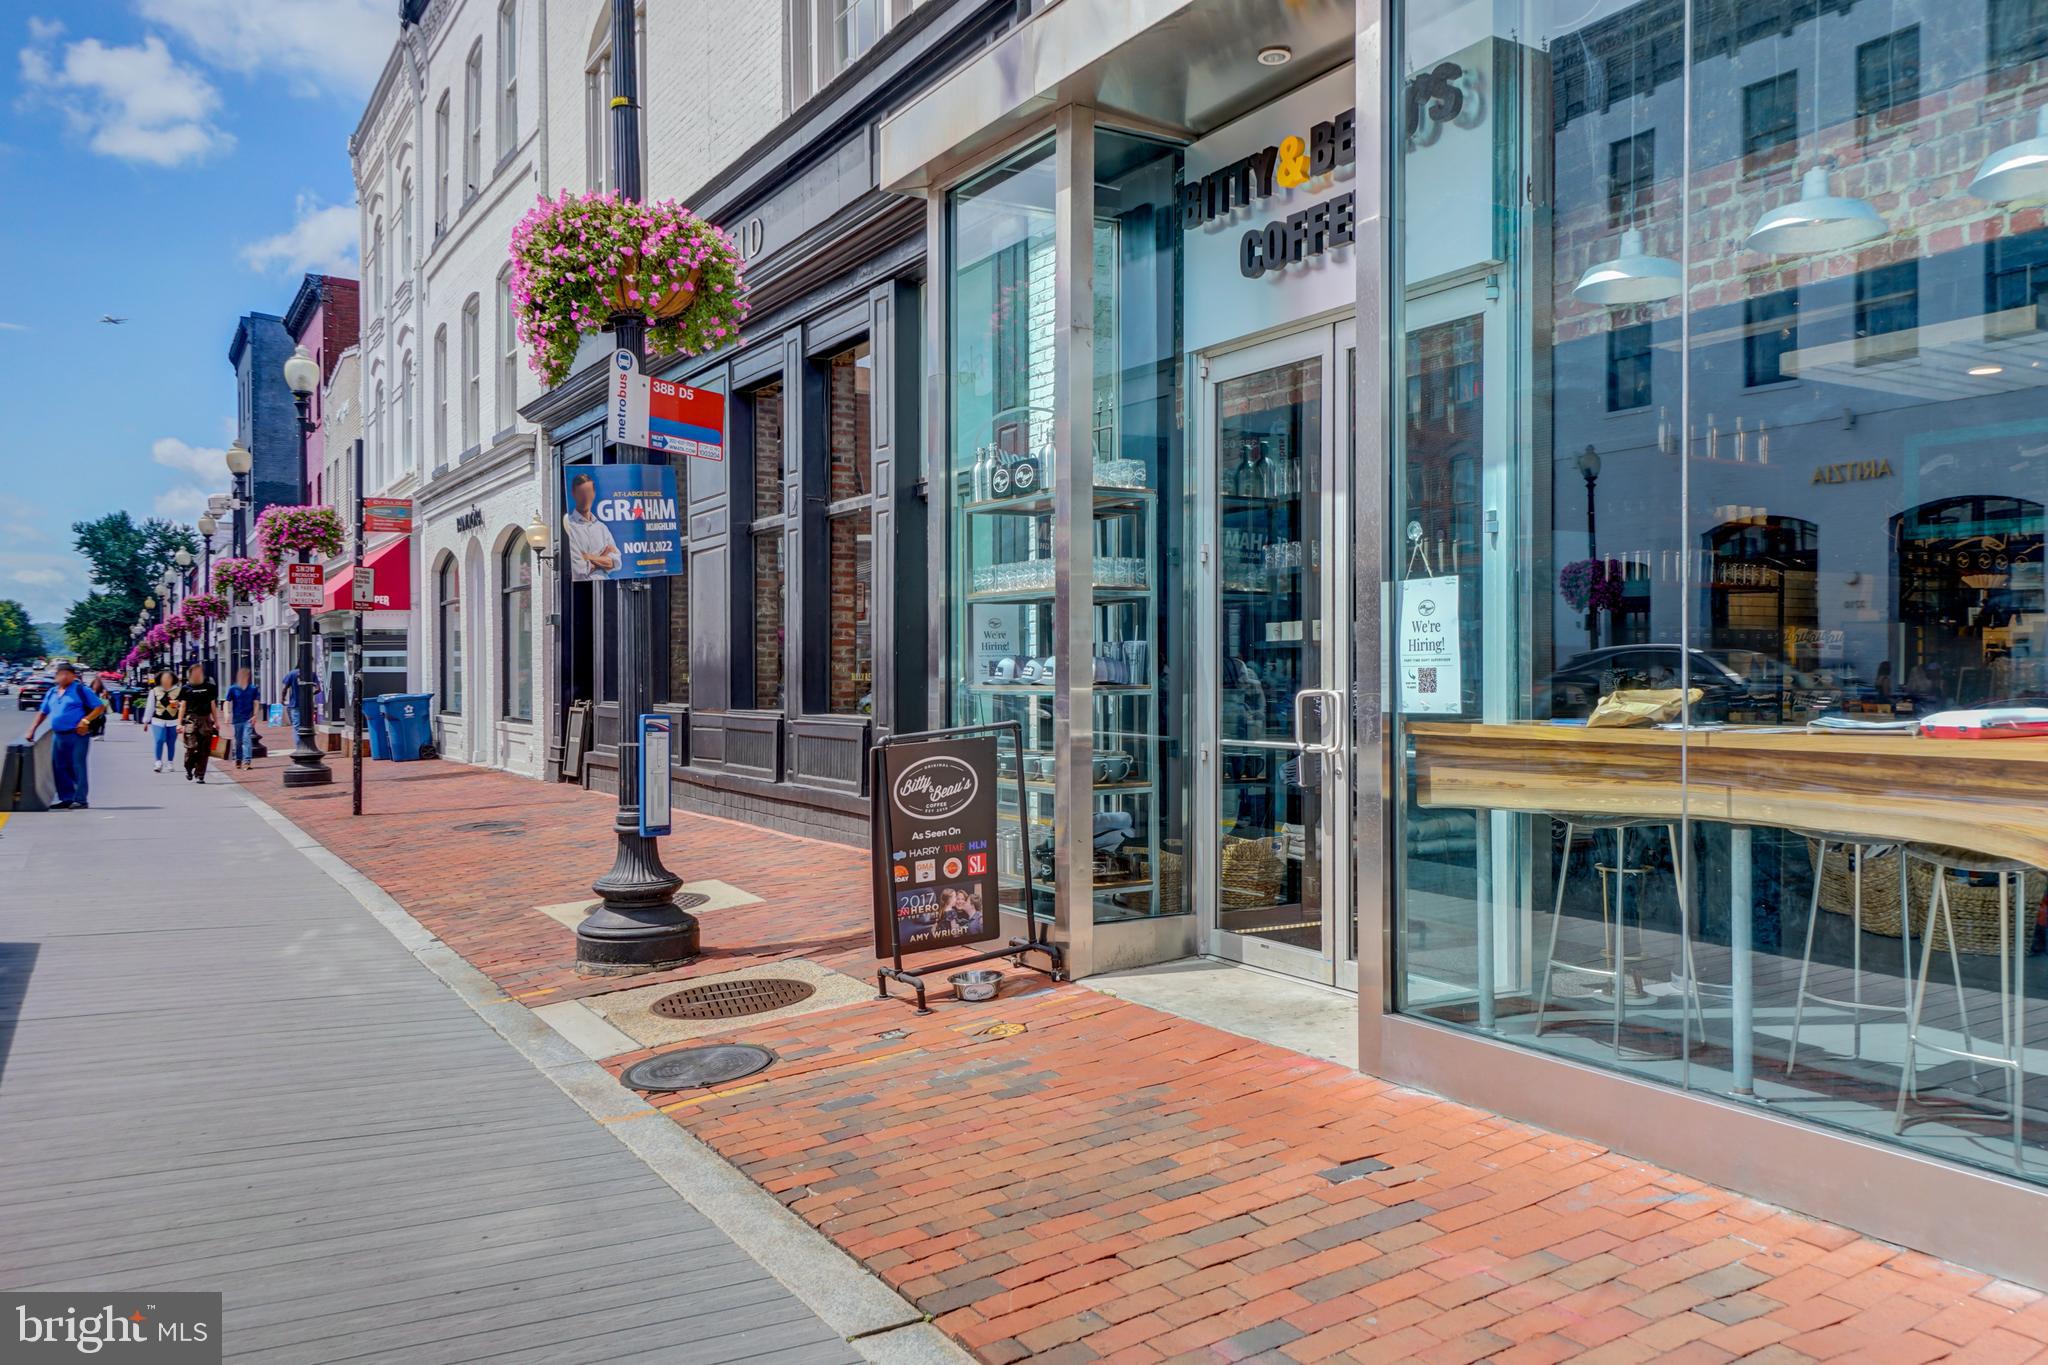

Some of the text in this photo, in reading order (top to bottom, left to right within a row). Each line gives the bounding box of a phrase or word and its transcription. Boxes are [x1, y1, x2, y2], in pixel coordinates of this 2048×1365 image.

[1182, 144, 1279, 230] BITTY
[1277, 134, 1311, 188] &
[1240, 190, 1355, 279] COFFE
[653, 381, 694, 400] 38B D5
[617, 373, 628, 439] metrobus
[596, 498, 676, 521] GRAHAM
[295, 565, 316, 573] SNOW
[984, 630, 1007, 639] We're
[1412, 620, 1441, 633] We're
[981, 641, 1010, 652] Hiring!
[1408, 637, 1445, 653] Hiring!
[900, 774, 932, 797] Bitty
[930, 777, 972, 802] Beau's
[926, 801, 947, 809] COFFEE
[911, 827, 961, 841] As Seen On
[909, 840, 987, 858] HARRY TIME HLN
[969, 855, 985, 874] SL
[901, 893, 935, 909] 2017
[911, 903, 939, 914] HERO
[909, 926, 969, 942] AMY WRIGHT
